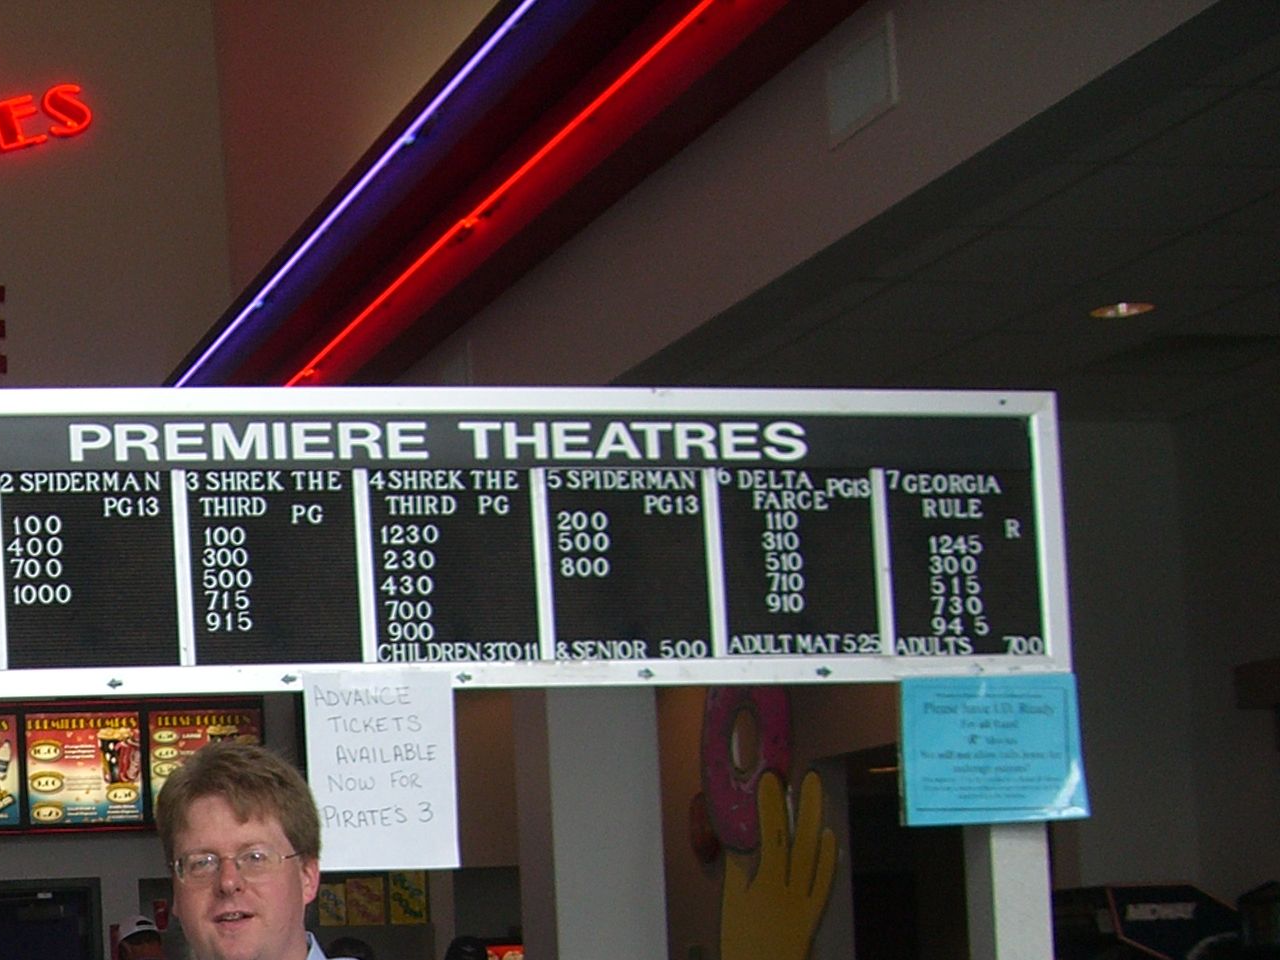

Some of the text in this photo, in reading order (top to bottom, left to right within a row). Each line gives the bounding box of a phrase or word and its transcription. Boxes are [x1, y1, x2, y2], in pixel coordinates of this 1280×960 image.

[69, 422, 807, 461] PREMIERE THEATRES
[21, 471, 160, 492] SPIDERMAN
[185, 471, 341, 493] 3 SHREK THE
[367, 470, 518, 492] 4 SHREK THE
[547, 469, 695, 489] 5 SPIDERMAN
[738, 470, 813, 489] DELTA
[884, 470, 1001, 493] 7 GEORGIA
[199, 497, 323, 523] THIRD PG
[385, 495, 509, 515] THIRD PG
[754, 491, 828, 510] FARCE
[14, 516, 61, 535] 100
[558, 511, 608, 530] 200
[766, 511, 799, 530] 110
[923, 499, 1020, 538] RULE R
[205, 527, 245, 546] 100
[381, 525, 438, 544] 1230
[559, 532, 609, 551] 500
[763, 532, 799, 550] 310
[7, 537, 62, 556] 400
[930, 535, 982, 554] 1245
[203, 548, 248, 567] 300
[384, 550, 435, 569] 230
[561, 557, 609, 576] 800
[766, 552, 803, 571] 510
[930, 556, 977, 574] 300
[11, 559, 62, 578] 700
[203, 569, 252, 588] 500
[381, 576, 433, 595] 430
[767, 573, 804, 591] 710
[932, 576, 981, 594] 515
[14, 584, 71, 604] 1000
[205, 590, 249, 610] 715
[766, 593, 804, 612] 910
[385, 601, 432, 620] 700
[932, 596, 983, 614] 730
[206, 612, 252, 631] 915
[388, 622, 434, 641] 900
[569, 641, 647, 659] SENIOR
[660, 640, 707, 659] 500
[729, 635, 792, 654] ADULT
[793, 635, 841, 653] MAT
[843, 633, 882, 653] 525
[896, 636, 974, 655] ADULTS
[1003, 635, 1044, 654] 700
[314, 685, 411, 707] ADVANCE
[328, 715, 422, 733] TICKETS
[336, 743, 437, 765] AVAILABLE
[327, 770, 423, 793] NOW FOR
[418, 801, 434, 823] 3
